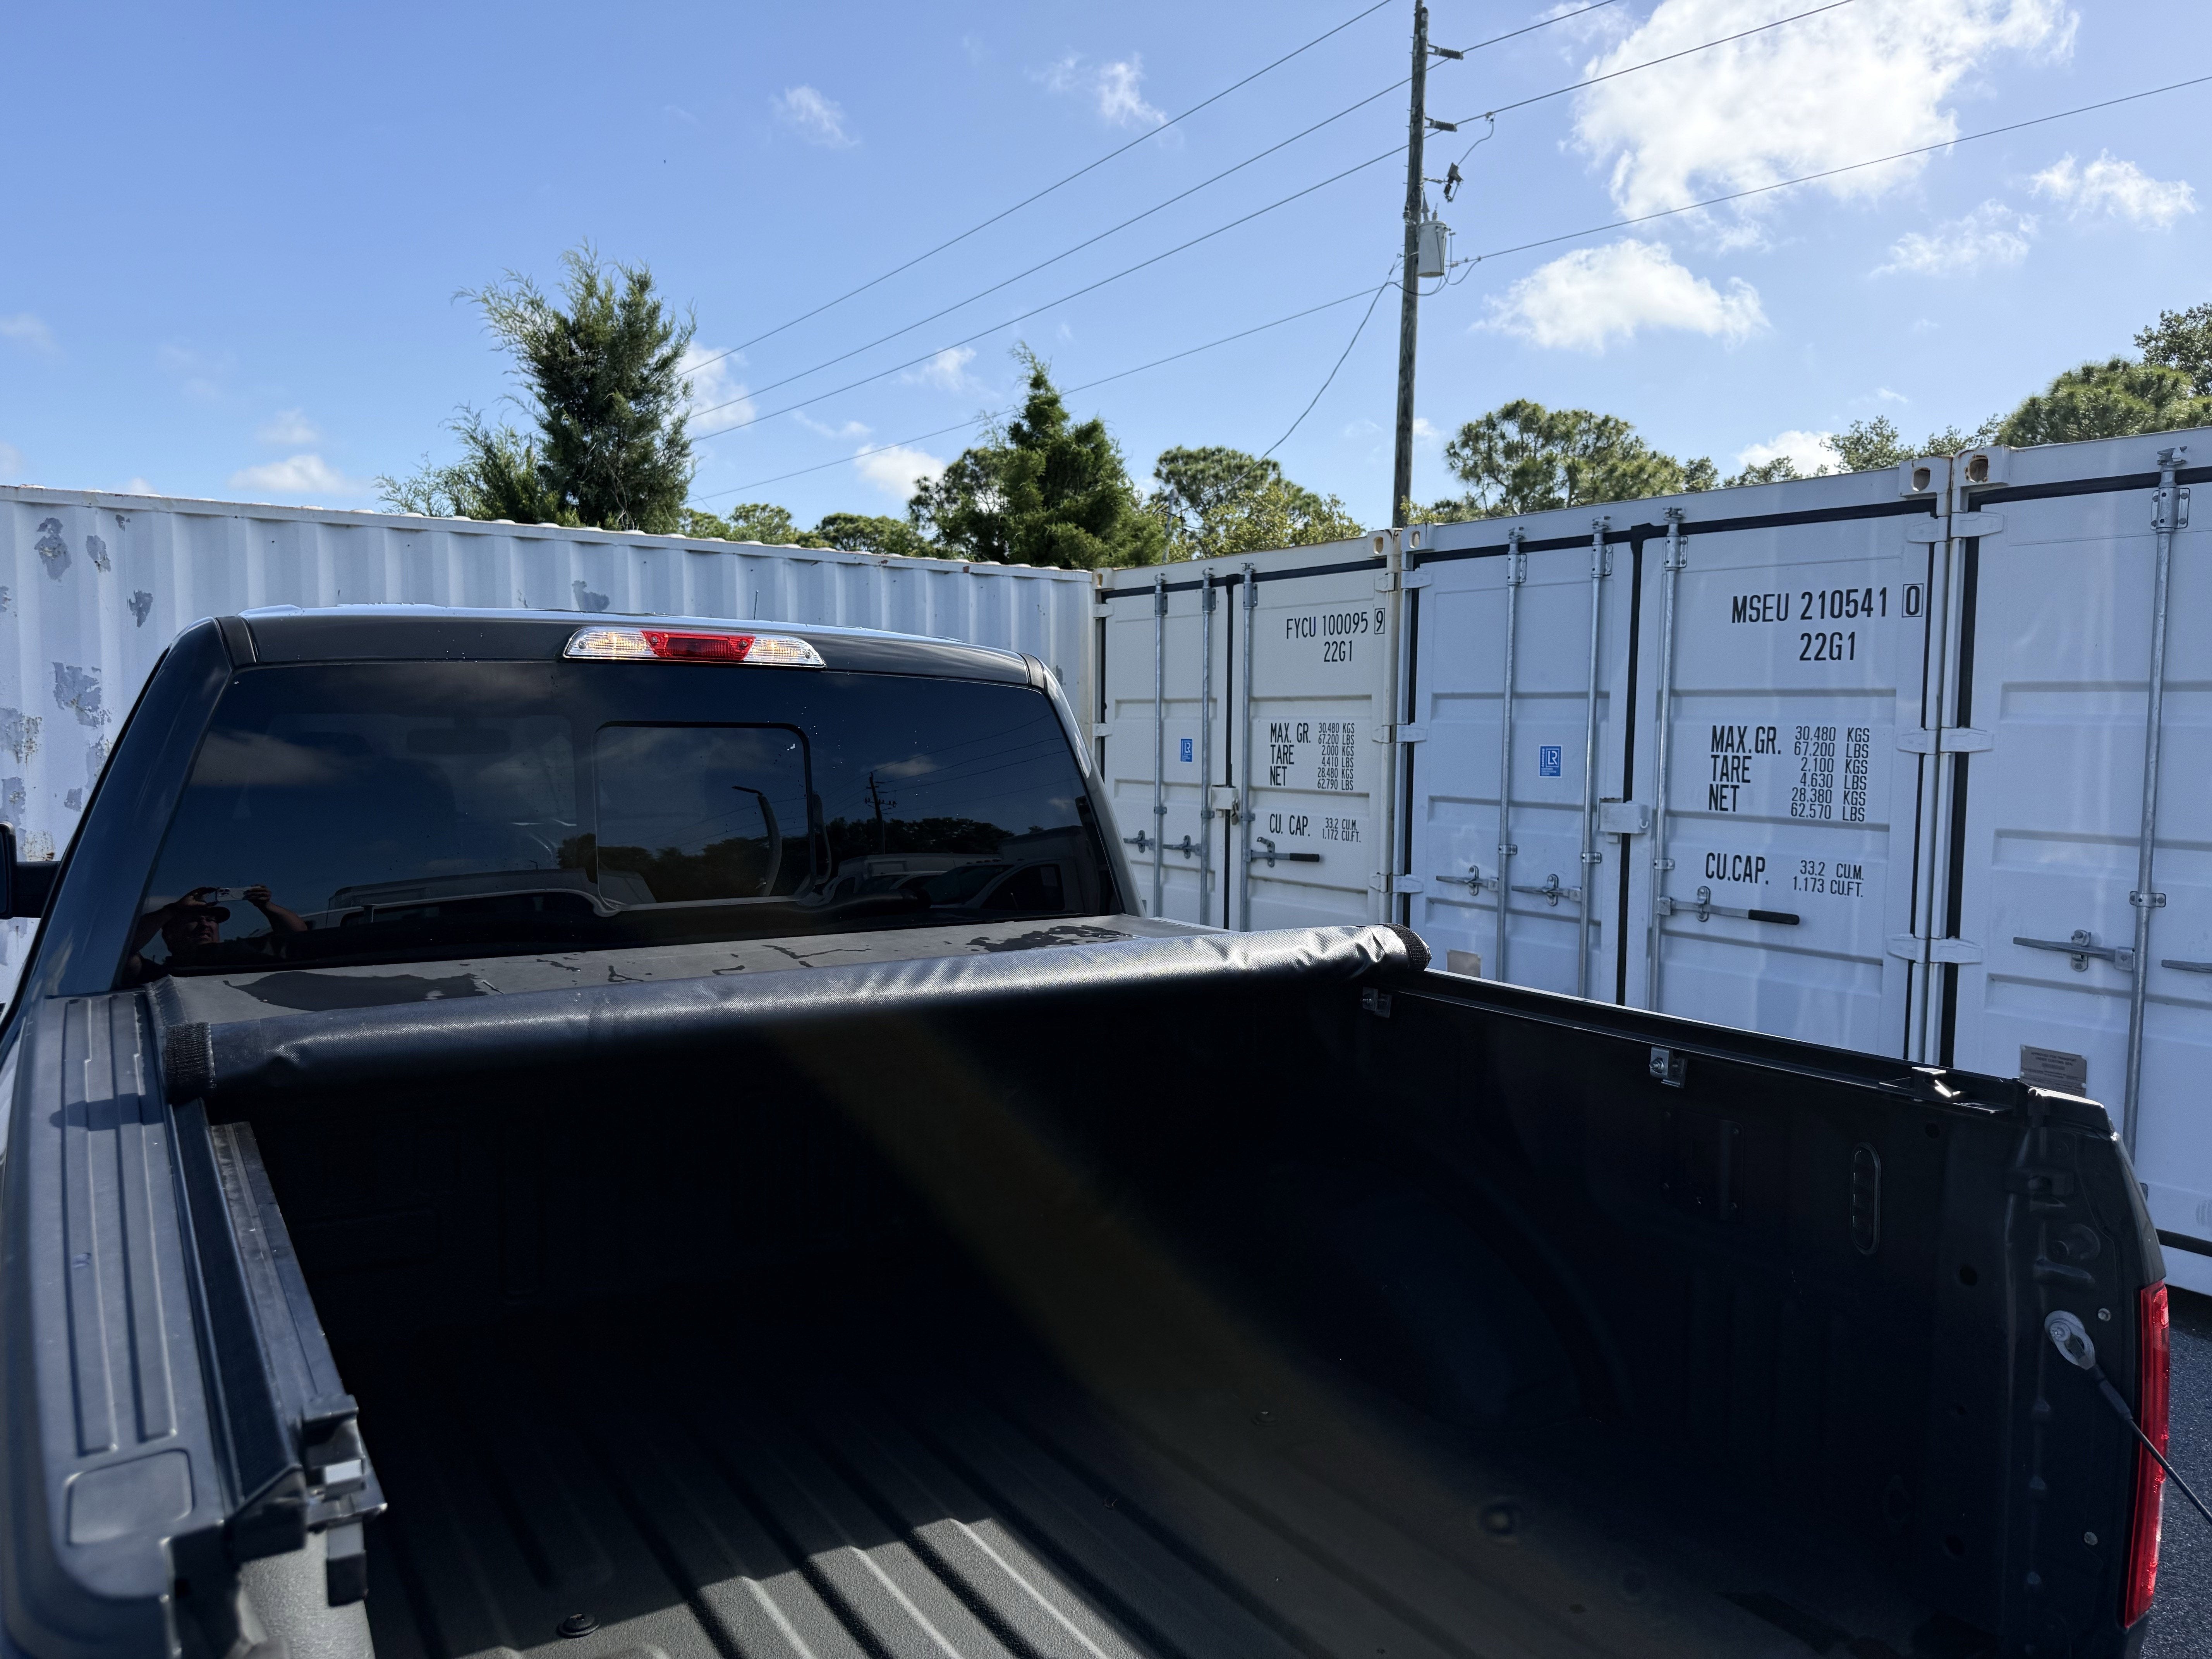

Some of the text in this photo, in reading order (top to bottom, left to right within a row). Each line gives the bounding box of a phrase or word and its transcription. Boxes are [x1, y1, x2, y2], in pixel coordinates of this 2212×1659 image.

[1732, 585, 1920, 623] MSEU 210541 0
[1286, 610, 1383, 639] FYCU 100095 9
[1324, 640, 1352, 662] 22G1
[1799, 631, 1855, 661] 22G1
[1270, 723, 1310, 744] MAX. GR.
[1319, 723, 1355, 734] 30.480 KGS
[1795, 726, 1870, 742] 30.480 KGS
[1318, 734, 1354, 745] 67.200 LBS
[1271, 744, 1294, 764] TARE
[1322, 745, 1354, 756] 2.000 KGS
[1794, 741, 1869, 758] 67.200 LBS
[1322, 757, 1353, 768] 4.410 LBS
[1711, 754, 1752, 783] TARE
[1801, 757, 1868, 775] 2.100 KGS
[1270, 766, 1287, 786] NET
[1318, 767, 1353, 779] 28.480 KGS
[1800, 773, 1867, 790] 4.630 LBS
[1317, 779, 1353, 790] 62.790 LBS
[1709, 783, 1740, 812] NET
[1791, 787, 1866, 806] 28.380 KGS
[1791, 802, 1865, 822] 62.570 LBS
[1270, 814, 1310, 836] CU. CAP.
[1325, 817, 1358, 831] 33.2 CU.M.
[1322, 828, 1361, 843] 1.172 CU.FT.
[1800, 860, 1864, 880] 33.2 CU.M.
[1793, 876, 1863, 897] 1.173 CU.FT.
